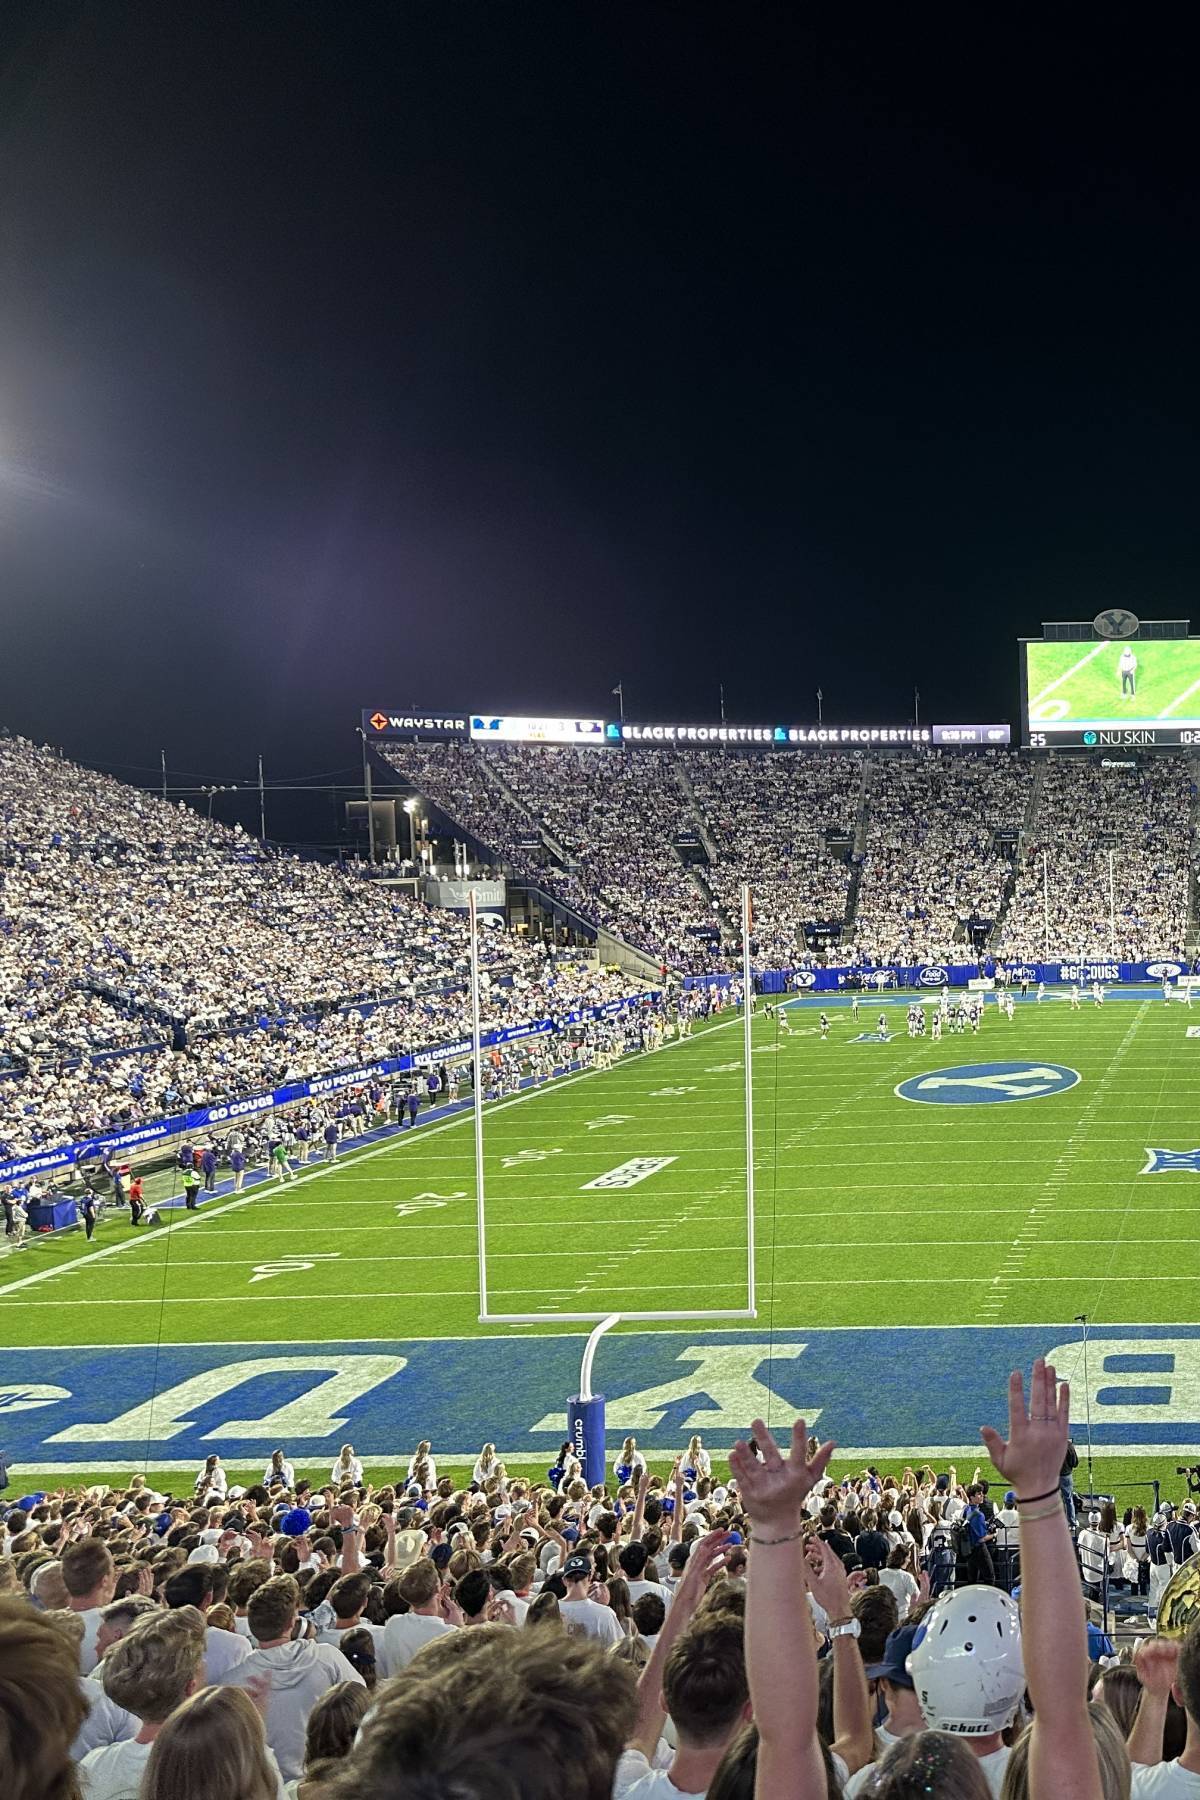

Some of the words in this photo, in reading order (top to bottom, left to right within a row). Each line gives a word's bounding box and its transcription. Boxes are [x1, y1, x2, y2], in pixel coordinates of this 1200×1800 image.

[389, 716, 465, 730] WAYSTAR
[622, 726, 675, 740] BLACK
[678, 727, 772, 741] PROPERTIES
[789, 729, 838, 741] BLACK
[842, 729, 929, 741] PROPERTIES
[1030, 734, 1046, 746] 25
[1099, 731, 1121, 745] NU
[1124, 731, 1155, 744] SKIN
[432, 1042, 472, 1060] COUGARS
[309, 1080, 332, 1094] BYU
[209, 1107, 228, 1121] GO
[229, 1095, 274, 1116] COUGS
[120, 1125, 167, 1145] FOOTBALL
[12, 1152, 69, 1175] FOOTBALL
[393, 1191, 468, 1210] 20
[251, 1251, 342, 1274] 10
[941, 1722, 990, 1733] schutt
